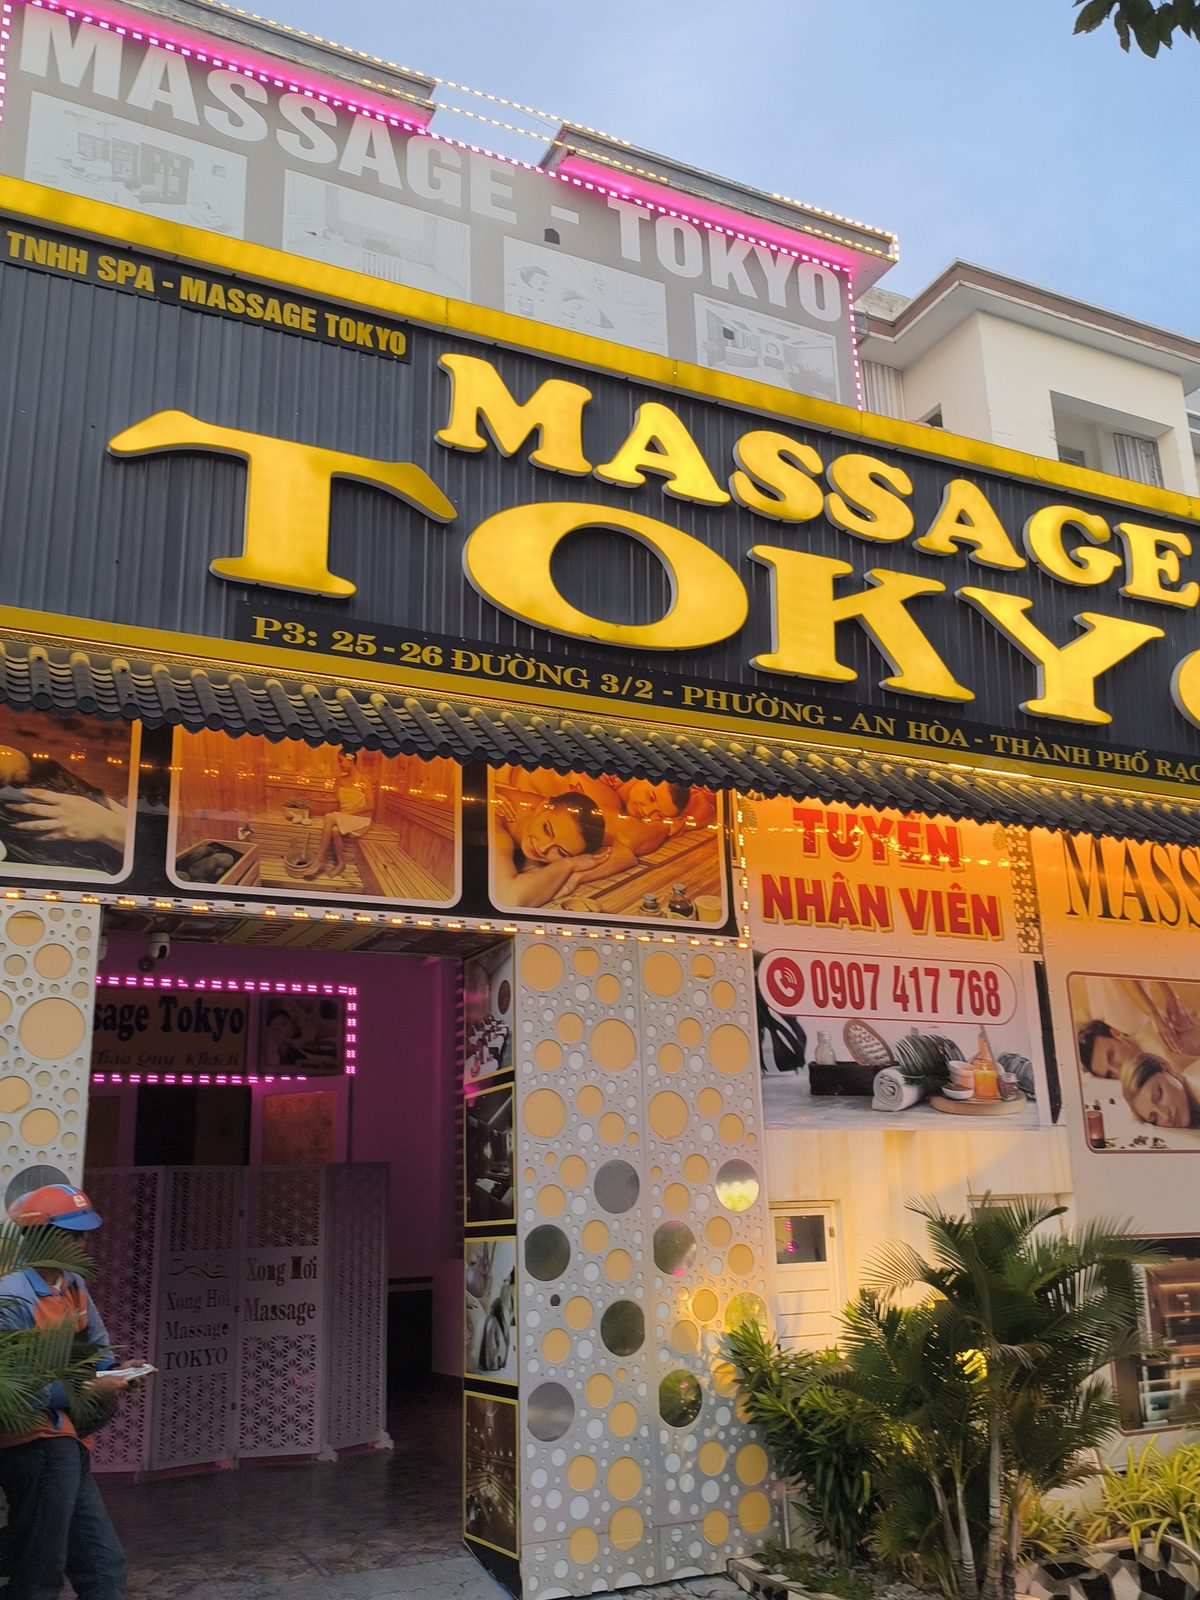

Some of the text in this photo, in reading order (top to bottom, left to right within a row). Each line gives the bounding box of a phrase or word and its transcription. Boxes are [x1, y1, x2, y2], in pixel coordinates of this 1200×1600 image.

[19, 3, 518, 224] MASSAGE
[607, 197, 843, 322] TOKYO
[7, 230, 88, 275] TNHH
[97, 255, 155, 292] SPA
[179, 275, 316, 333] MASSAGE
[324, 312, 407, 356] TOKYO
[434, 352, 1200, 609] MASSAGE
[107, 409, 1200, 730] TOKY
[252, 616, 318, 647] P3:
[450, 648, 590, 690] ĐƯỜNG
[601, 673, 654, 701] 3/2
[681, 685, 825, 727] PHƯỜNG
[850, 712, 895, 738] AN
[907, 720, 968, 748] HÒA
[990, 733, 1091, 766] THÀNH
[1096, 750, 1150, 773] PHỐ
[761, 871, 1001, 938] NHÂN VIÊN
[158, 995, 245, 1042] Tokyo
[811, 960, 1001, 1016] 0907 417 768
[164, 1320, 229, 1341] Massage
[244, 1296, 316, 1326] Massage
[164, 1346, 228, 1370] TOKYO
